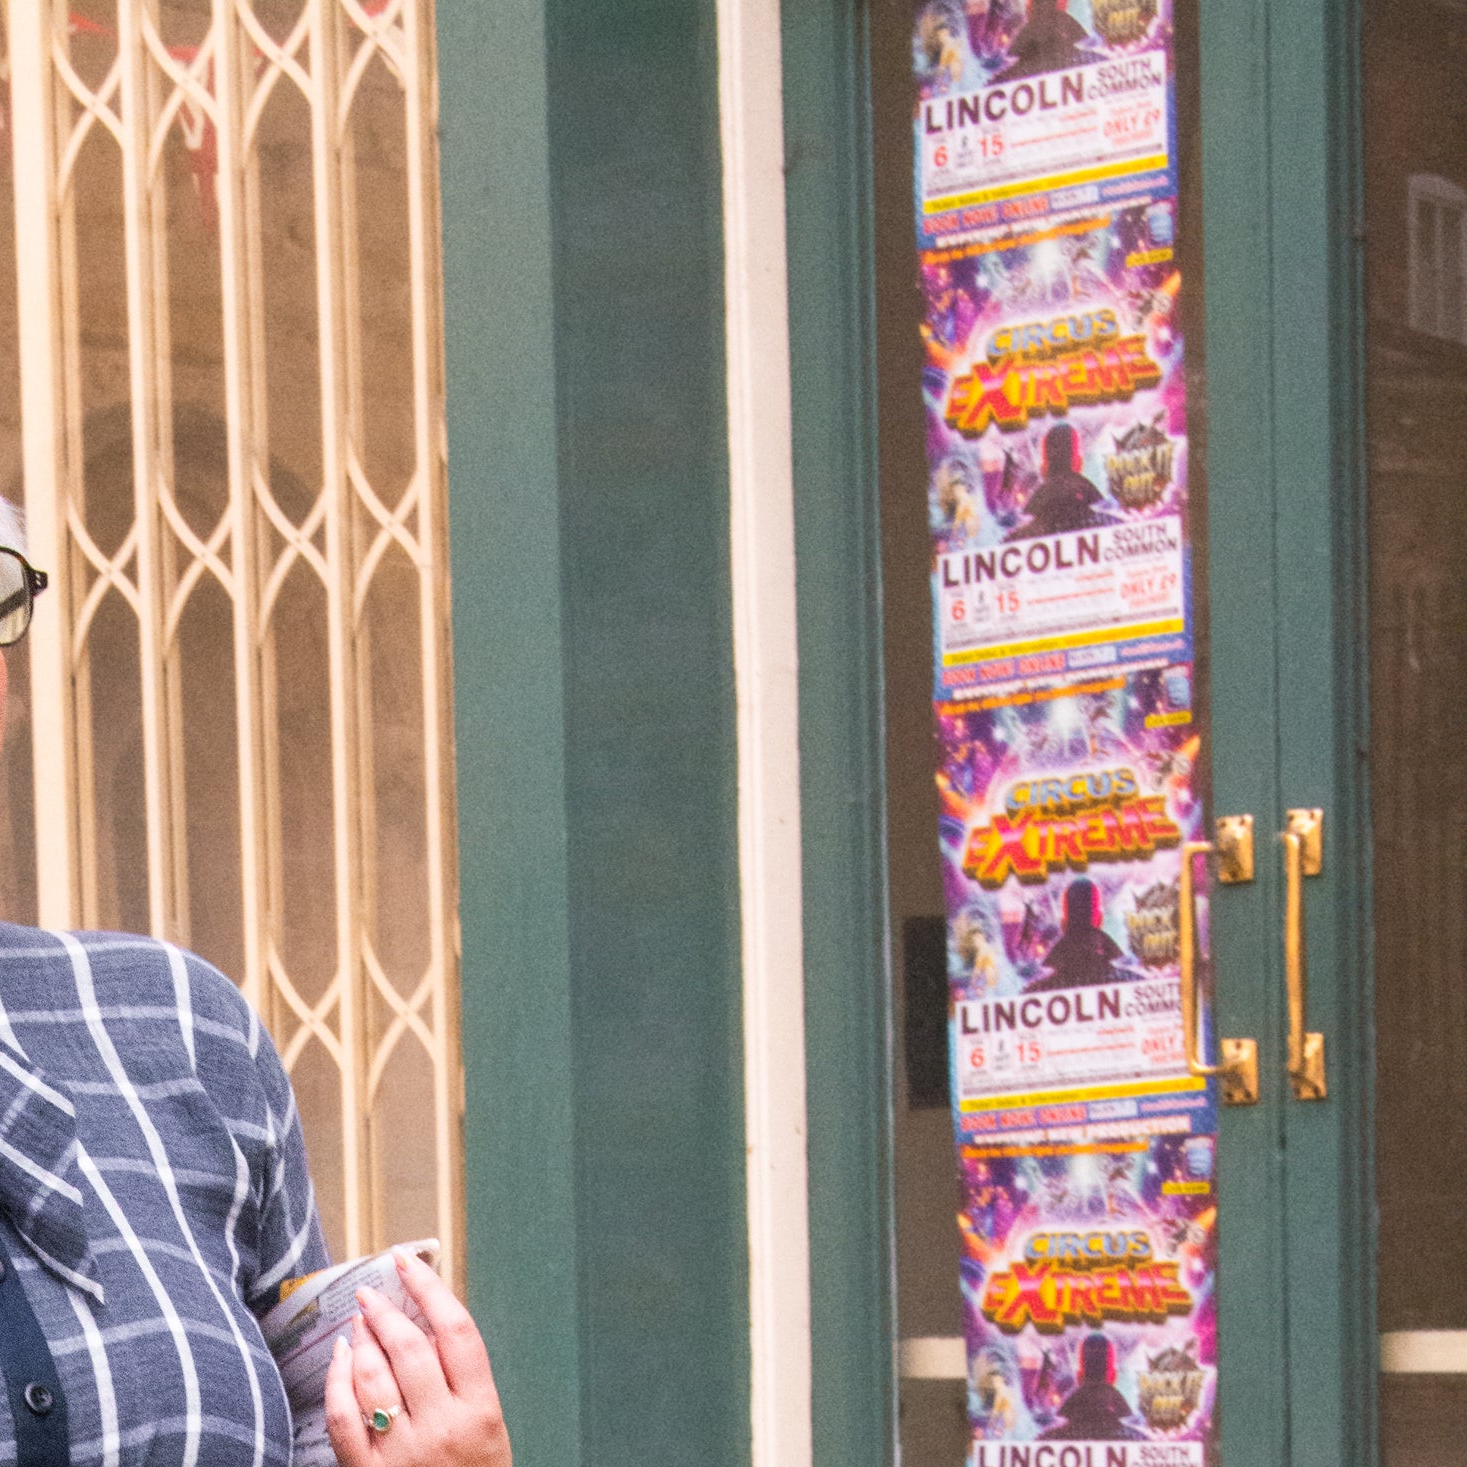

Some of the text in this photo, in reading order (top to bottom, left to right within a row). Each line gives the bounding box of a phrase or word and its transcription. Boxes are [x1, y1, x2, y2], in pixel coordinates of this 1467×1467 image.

[1098, 58, 1151, 82] SOUTH
[1087, 73, 1163, 100] COMMON
[925, 72, 1084, 134] LINCOLN
[934, 146, 948, 167] 6
[980, 134, 1004, 158] 15
[986, 308, 1119, 362] CIRCUS
[944, 335, 1162, 440] EXTREME
[1112, 523, 1167, 544] SOUTH
[942, 534, 1100, 587] LINCOLN
[1104, 538, 1177, 562] COMMON
[951, 601, 965, 621] 6
[996, 590, 1020, 613] 15
[1005, 767, 1139, 816] CIRCUS
[963, 795, 1181, 890] EXTREME
[1134, 983, 1182, 1001] SOUT
[961, 989, 1121, 1035] LINCOLN
[971, 1048, 984, 1068] 6
[1017, 1041, 1041, 1064] 15
[1025, 1230, 1154, 1269] CIRCUS
[982, 1261, 1194, 1336] EXTREME
[1139, 1446, 1190, 1462] SOUTH
